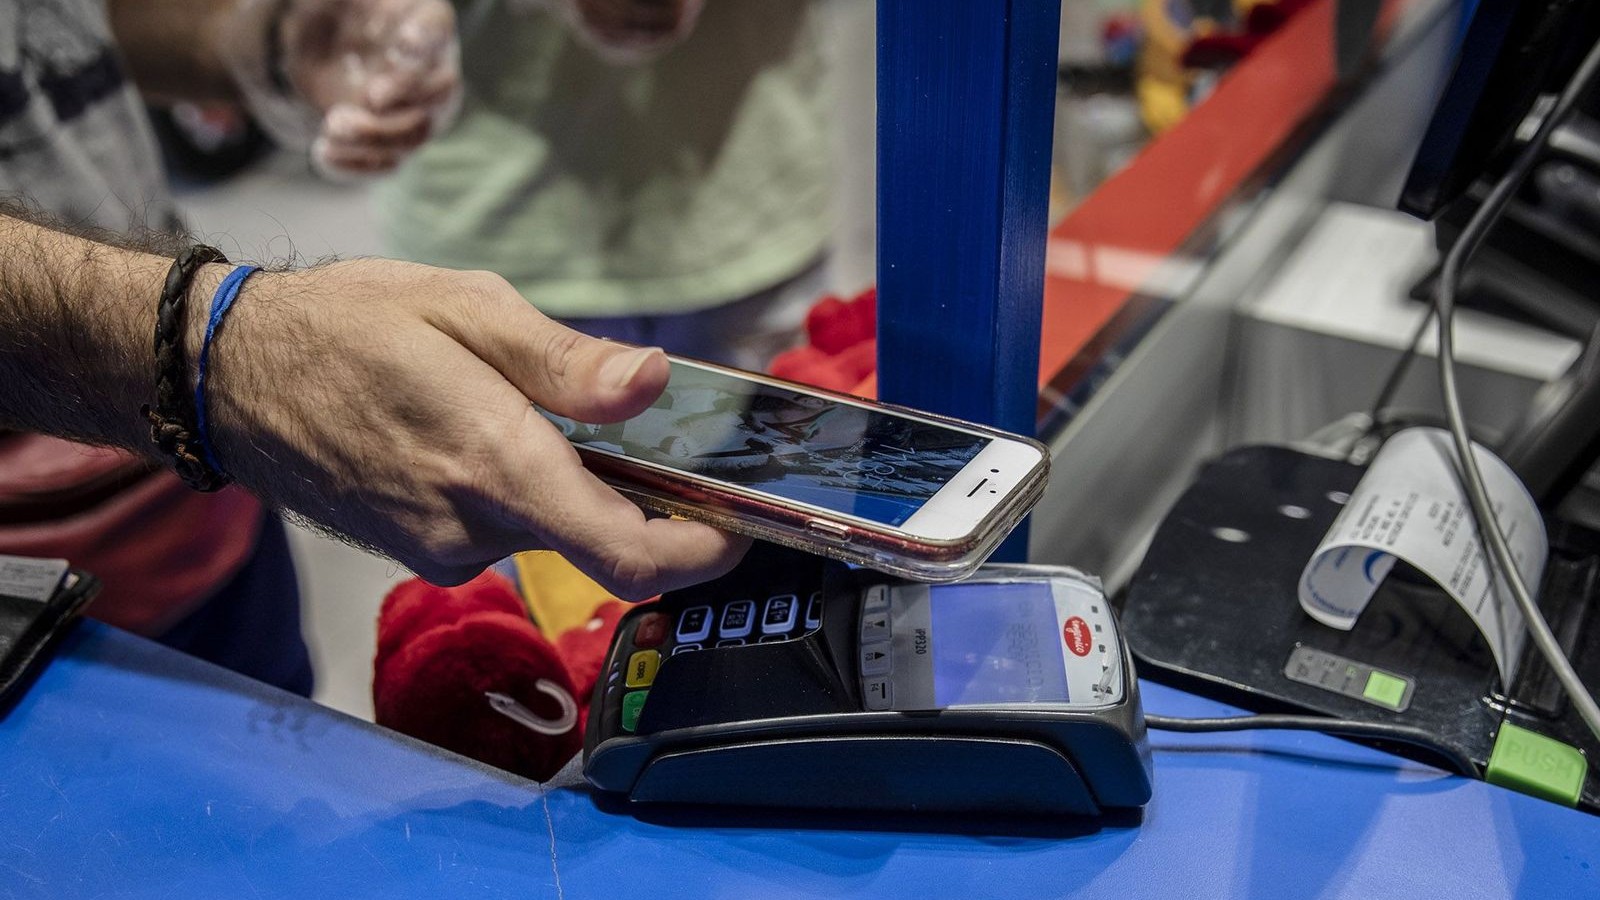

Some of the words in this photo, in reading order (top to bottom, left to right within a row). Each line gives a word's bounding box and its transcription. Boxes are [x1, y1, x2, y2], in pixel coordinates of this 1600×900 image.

[915, 628, 928, 655] iPP320
[1065, 620, 1088, 654] ingenico
[870, 683, 880, 692] F4
[1504, 741, 1577, 779] PUSH
